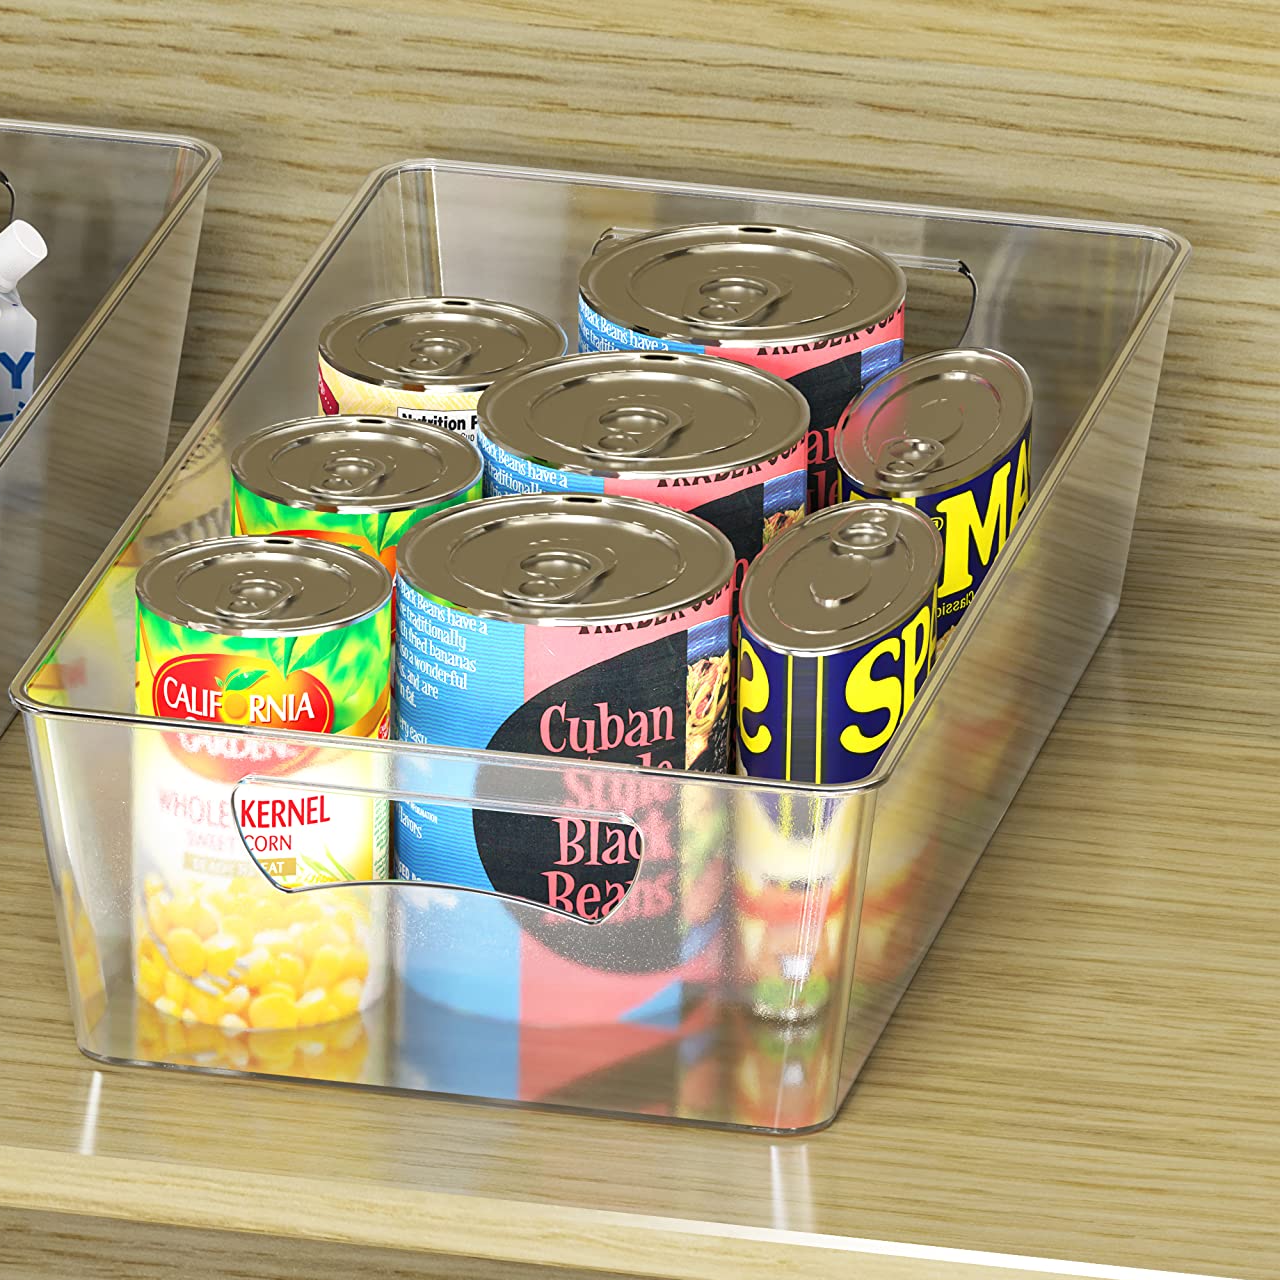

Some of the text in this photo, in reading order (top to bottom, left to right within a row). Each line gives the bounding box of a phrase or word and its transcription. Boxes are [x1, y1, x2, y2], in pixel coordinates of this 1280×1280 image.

[498, 446, 527, 476] Beans
[526, 459, 557, 485] have
[407, 606, 467, 652] traditionally
[417, 592, 446, 623] Beans
[446, 606, 477, 631] have
[478, 620, 489, 635] a
[408, 628, 428, 655] fried
[429, 640, 477, 672] bananas
[415, 656, 468, 691] wonderful
[421, 680, 439, 700] are
[539, 701, 676, 754] Cuban
[240, 795, 331, 829] KERNEL
[244, 834, 292, 852] CORN
